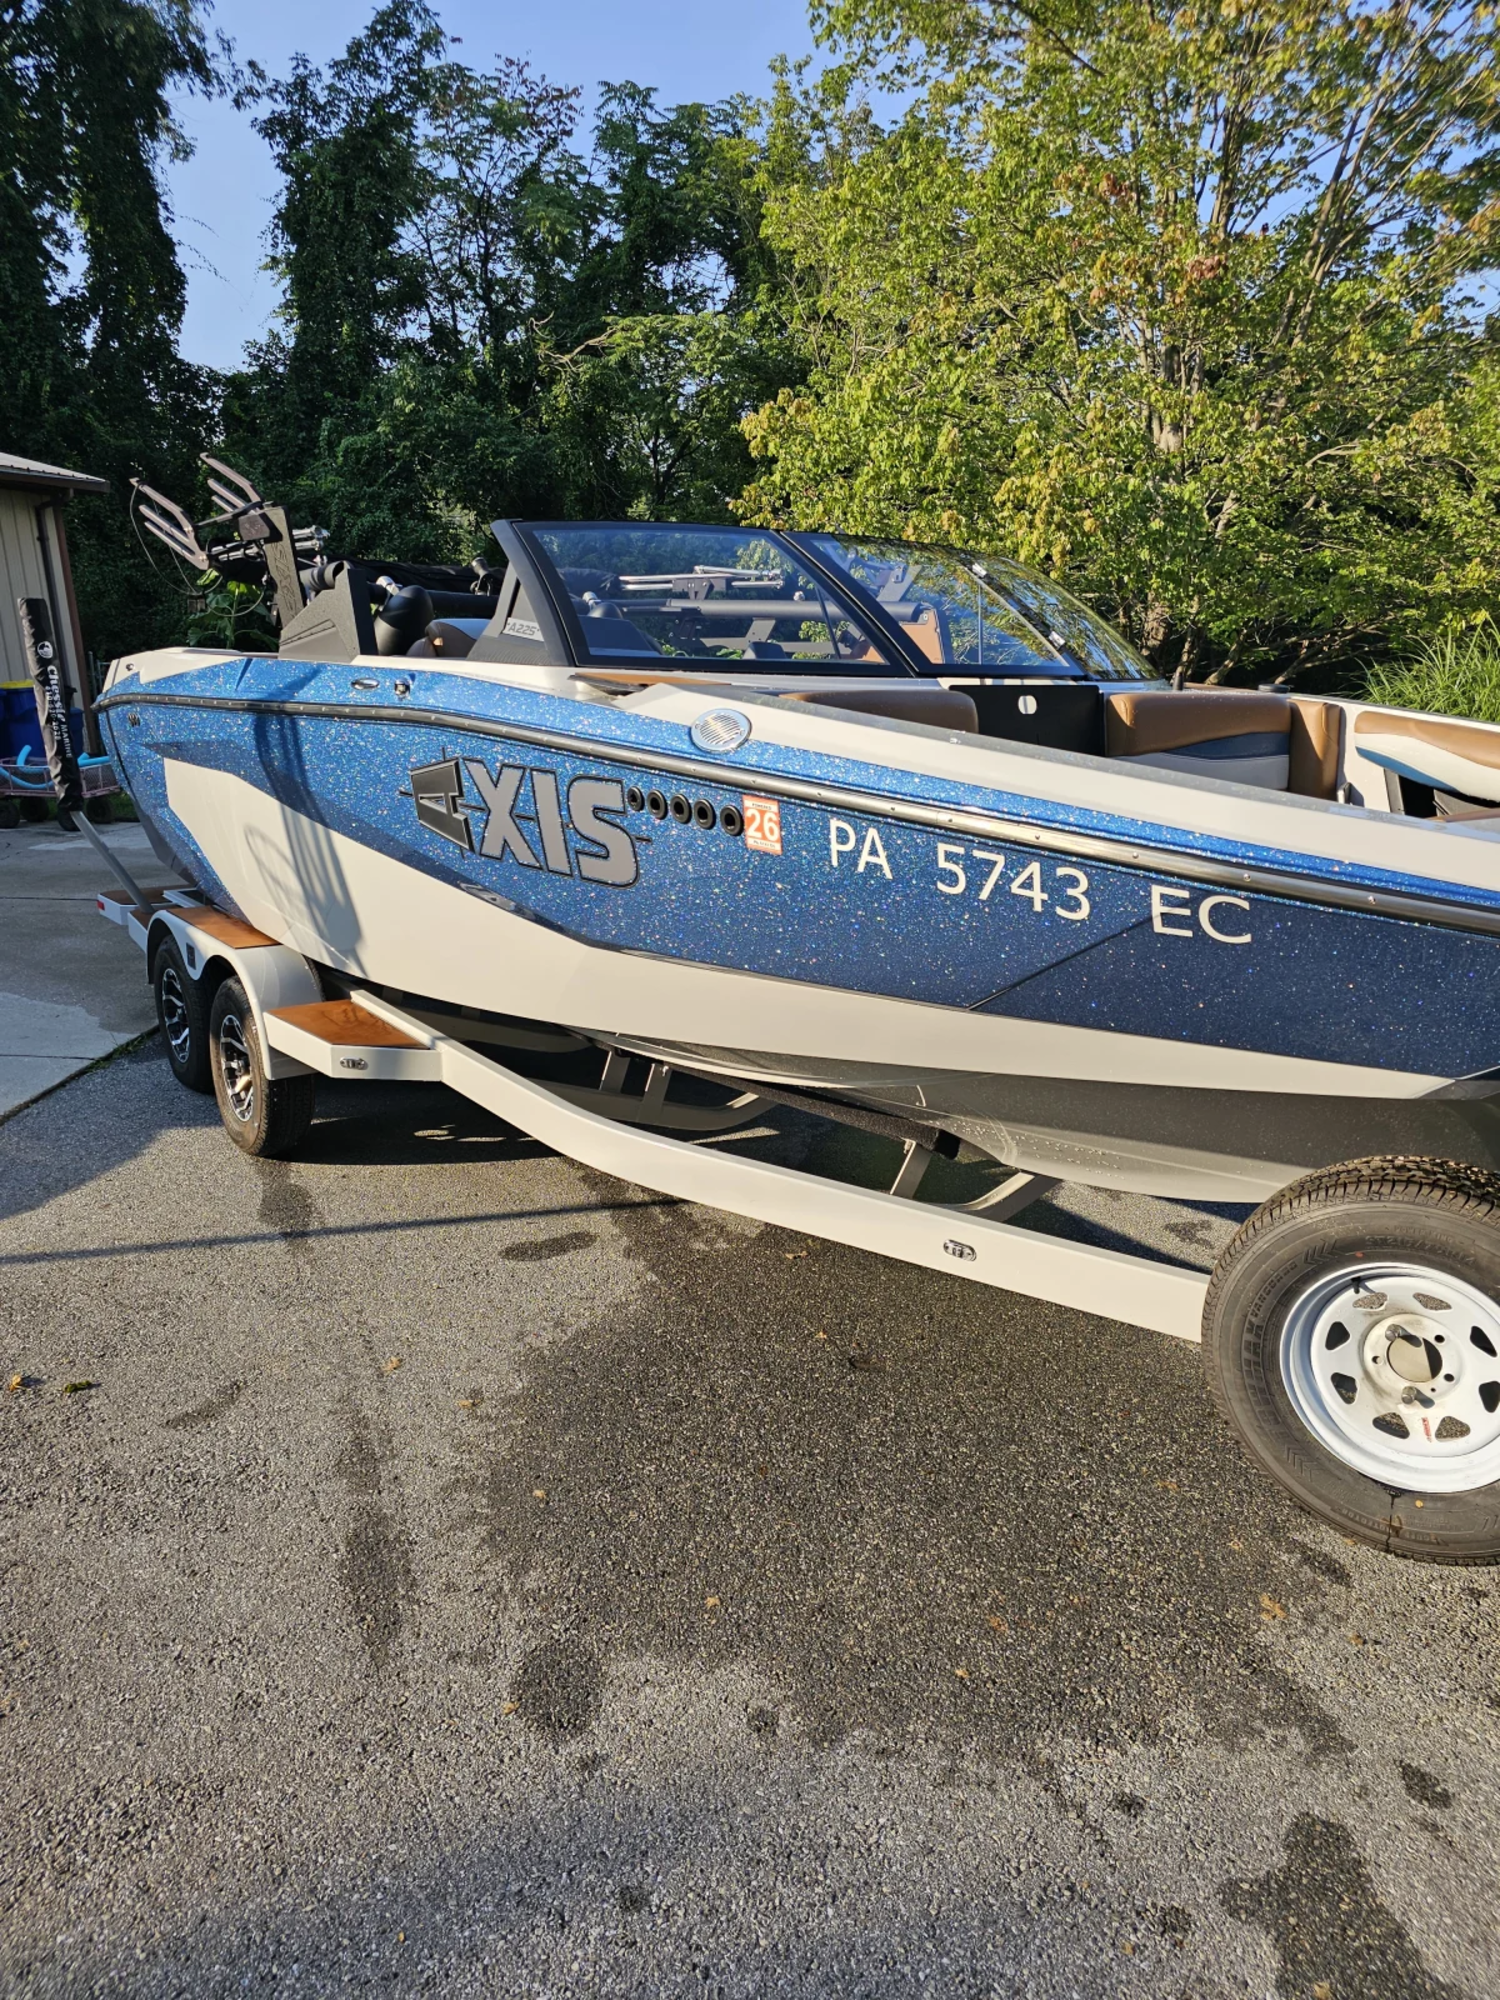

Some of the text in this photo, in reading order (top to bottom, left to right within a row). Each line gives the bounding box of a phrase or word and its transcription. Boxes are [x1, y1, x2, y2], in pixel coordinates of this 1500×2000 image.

[507, 622, 537, 636] A225
[47, 665, 72, 757] Chessie MARINE
[409, 756, 640, 890] AXIS
[746, 808, 779, 842] 26
[829, 818, 1252, 944] PA 5743 EC
